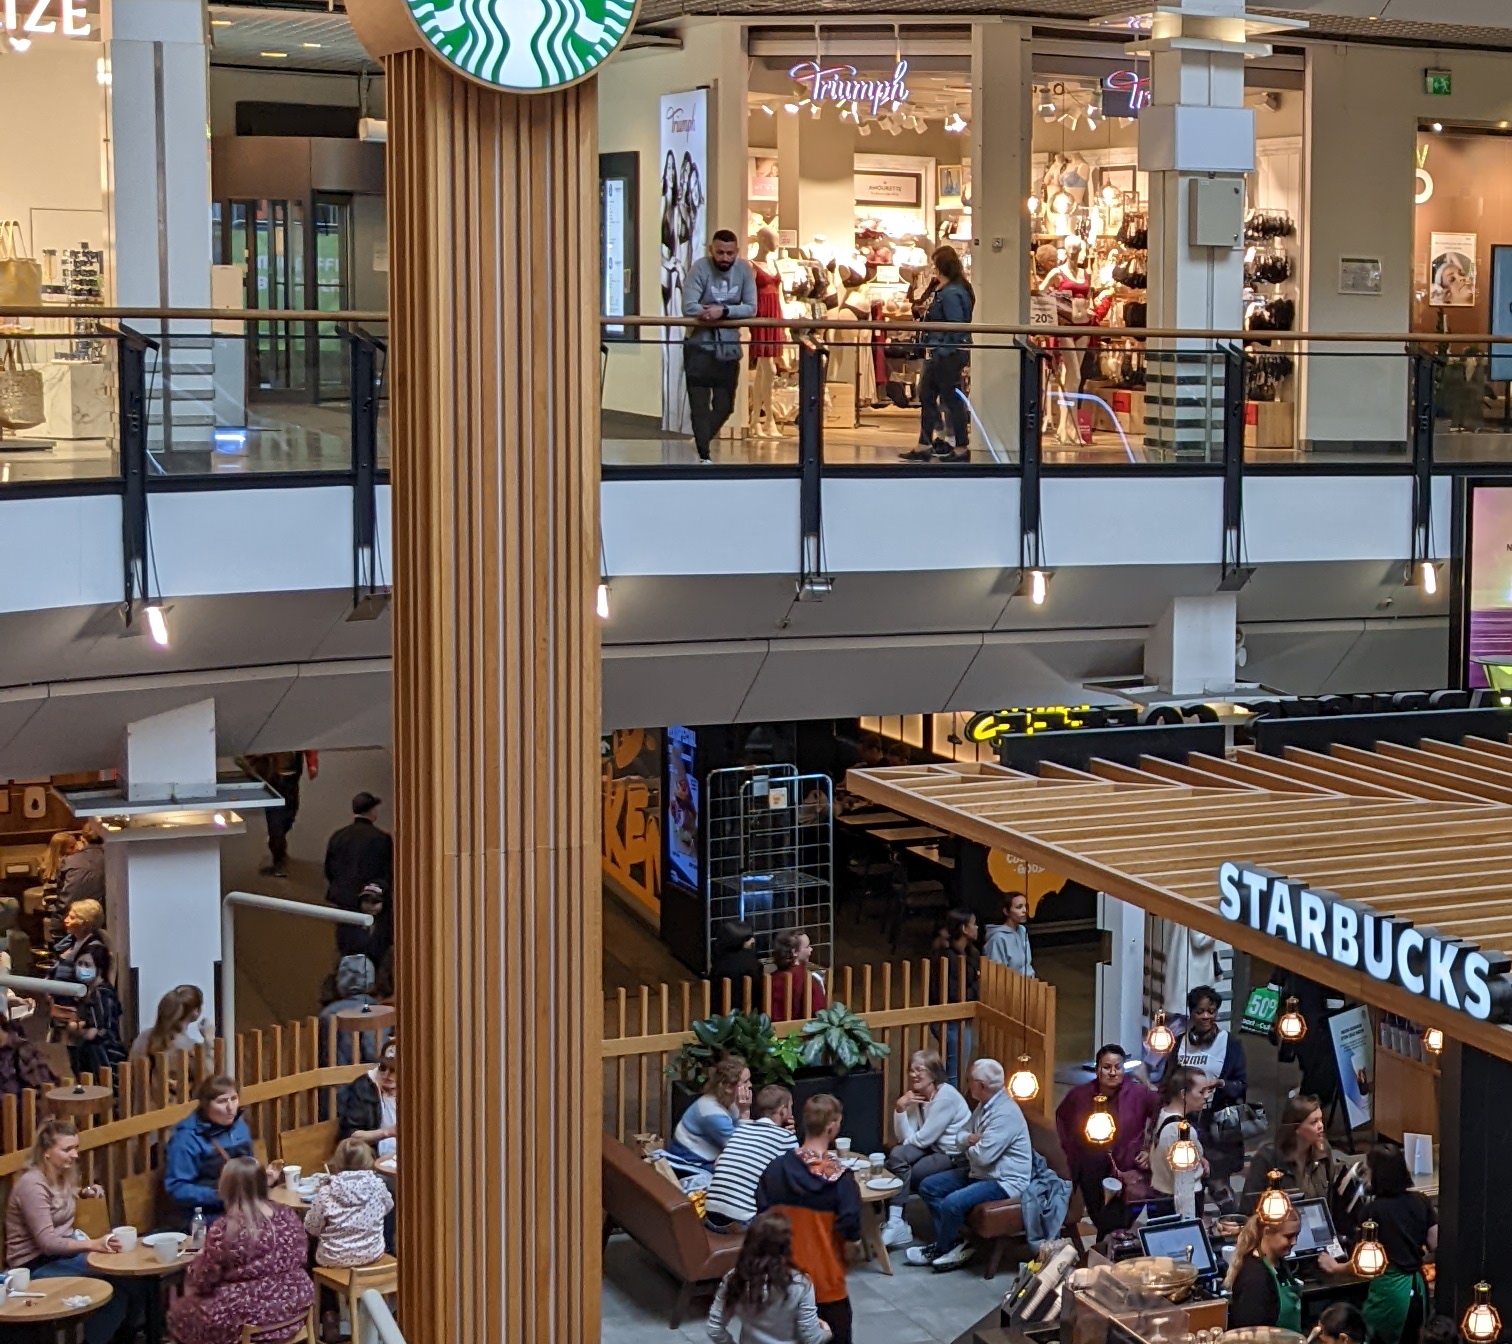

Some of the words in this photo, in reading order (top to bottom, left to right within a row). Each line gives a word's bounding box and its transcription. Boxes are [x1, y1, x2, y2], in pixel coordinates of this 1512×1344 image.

[790, 60, 909, 116] Triumph
[667, 103, 697, 144] Triumph
[1218, 860, 1497, 1021] STARBUCKS
